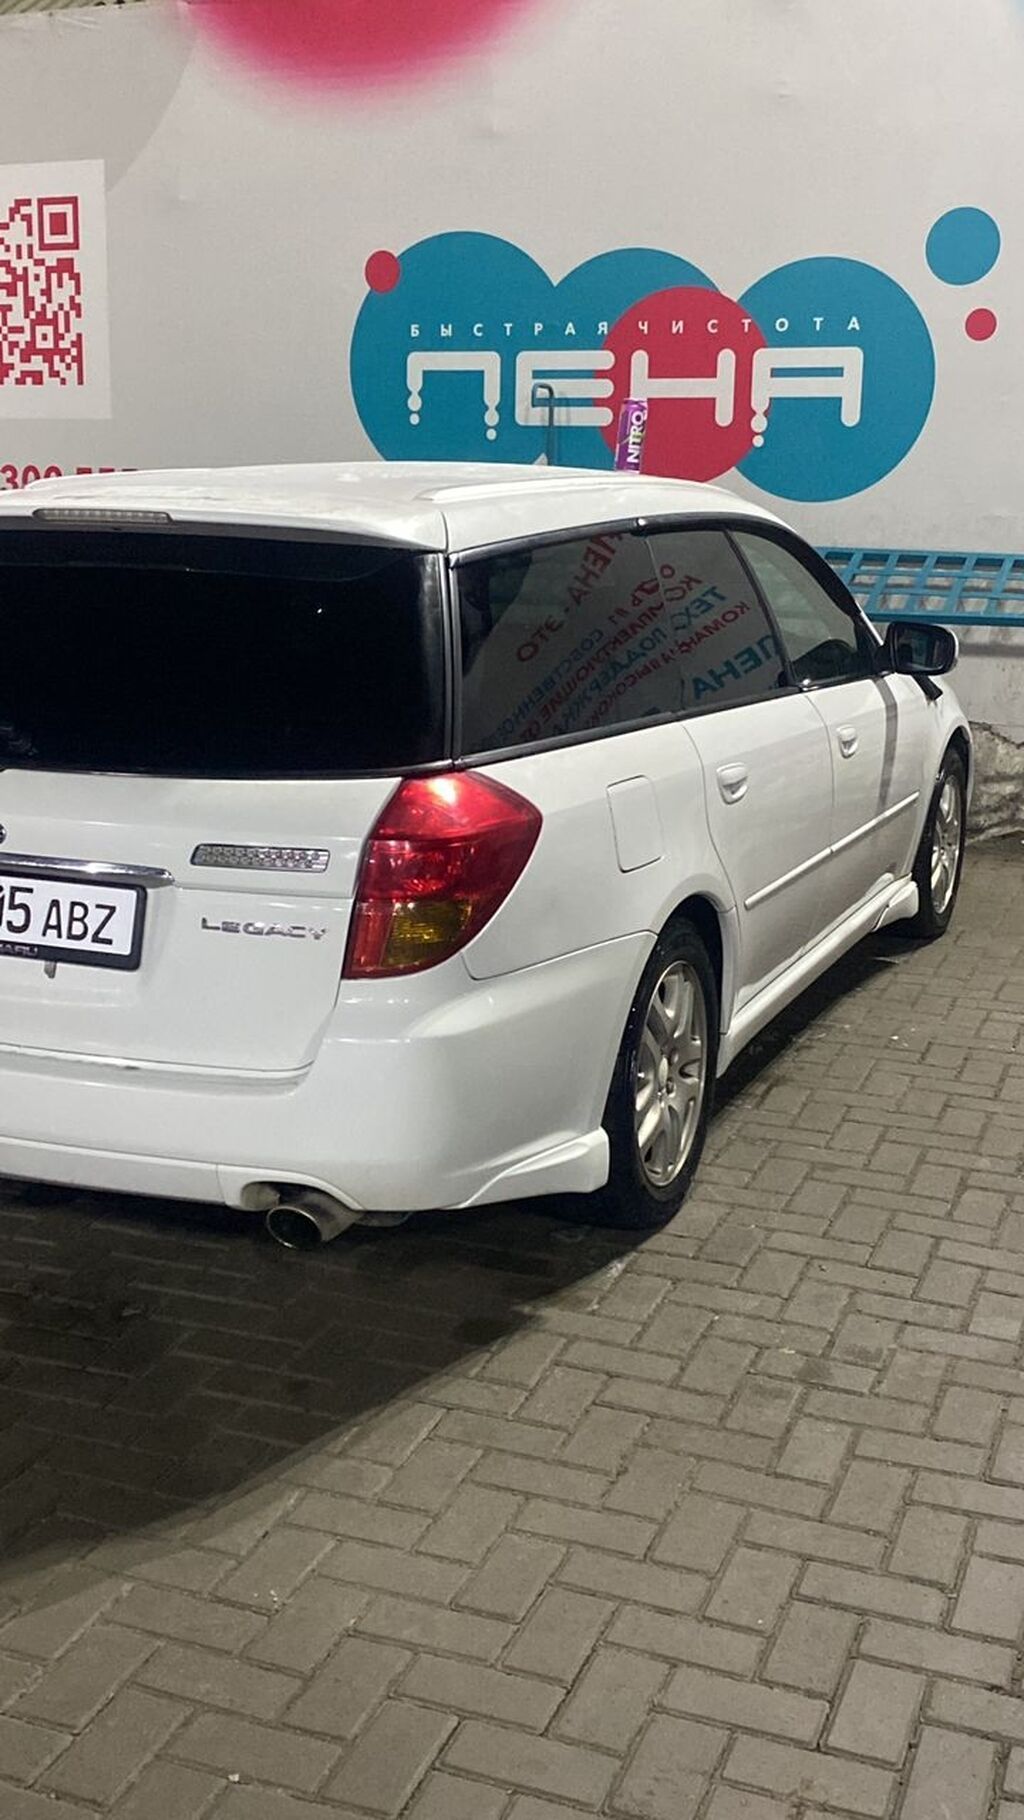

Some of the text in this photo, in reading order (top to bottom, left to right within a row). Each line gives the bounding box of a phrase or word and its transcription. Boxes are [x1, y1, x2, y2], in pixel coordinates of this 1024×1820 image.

[410, 316, 861, 338] БЫСТРАЯ ЧИСТОТА
[406, 347, 864, 447] ПЕНА
[626, 410, 644, 464] NITRO
[41, 899, 117, 946] ABZ
[201, 917, 327, 941] LEGACY
